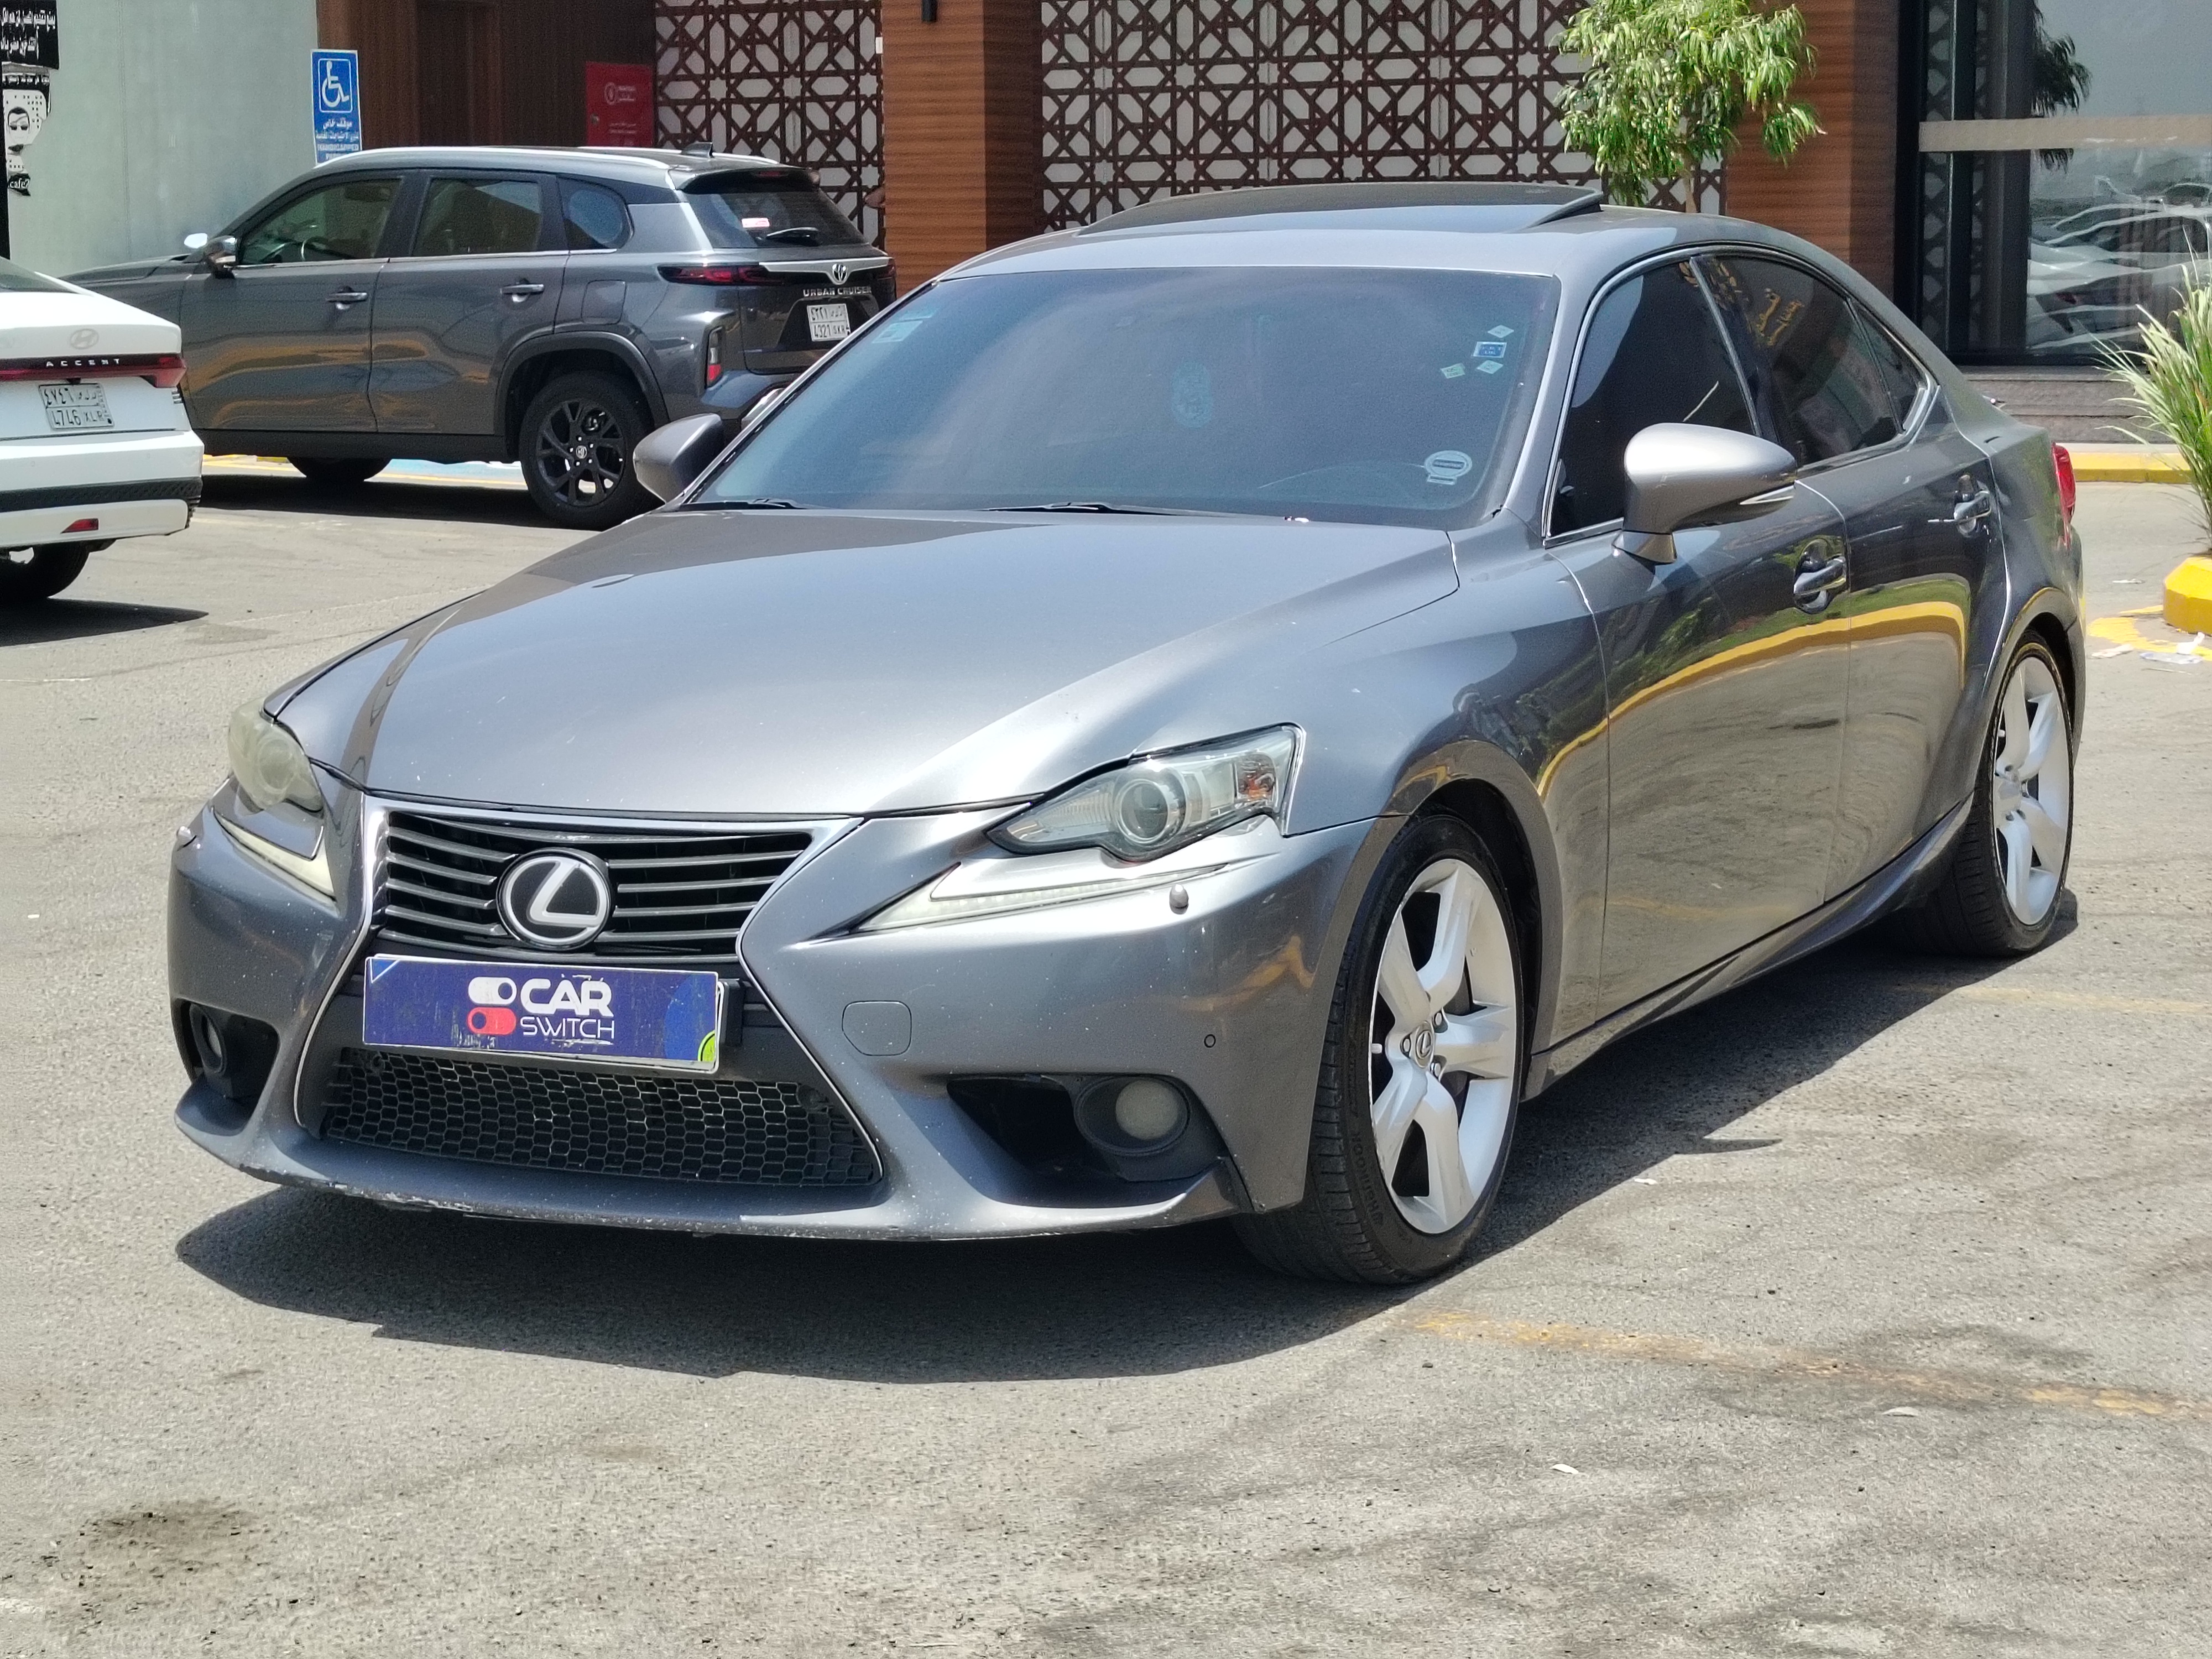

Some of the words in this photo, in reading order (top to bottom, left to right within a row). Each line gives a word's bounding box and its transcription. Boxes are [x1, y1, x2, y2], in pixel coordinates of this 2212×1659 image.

[803, 288, 835, 296] URBAN
[837, 286, 872, 295] CRUISER
[814, 324, 831, 338] 4321
[46, 358, 119, 367] ACCENT
[521, 977, 614, 1018] CAR
[520, 1016, 615, 1039] SWITCH
